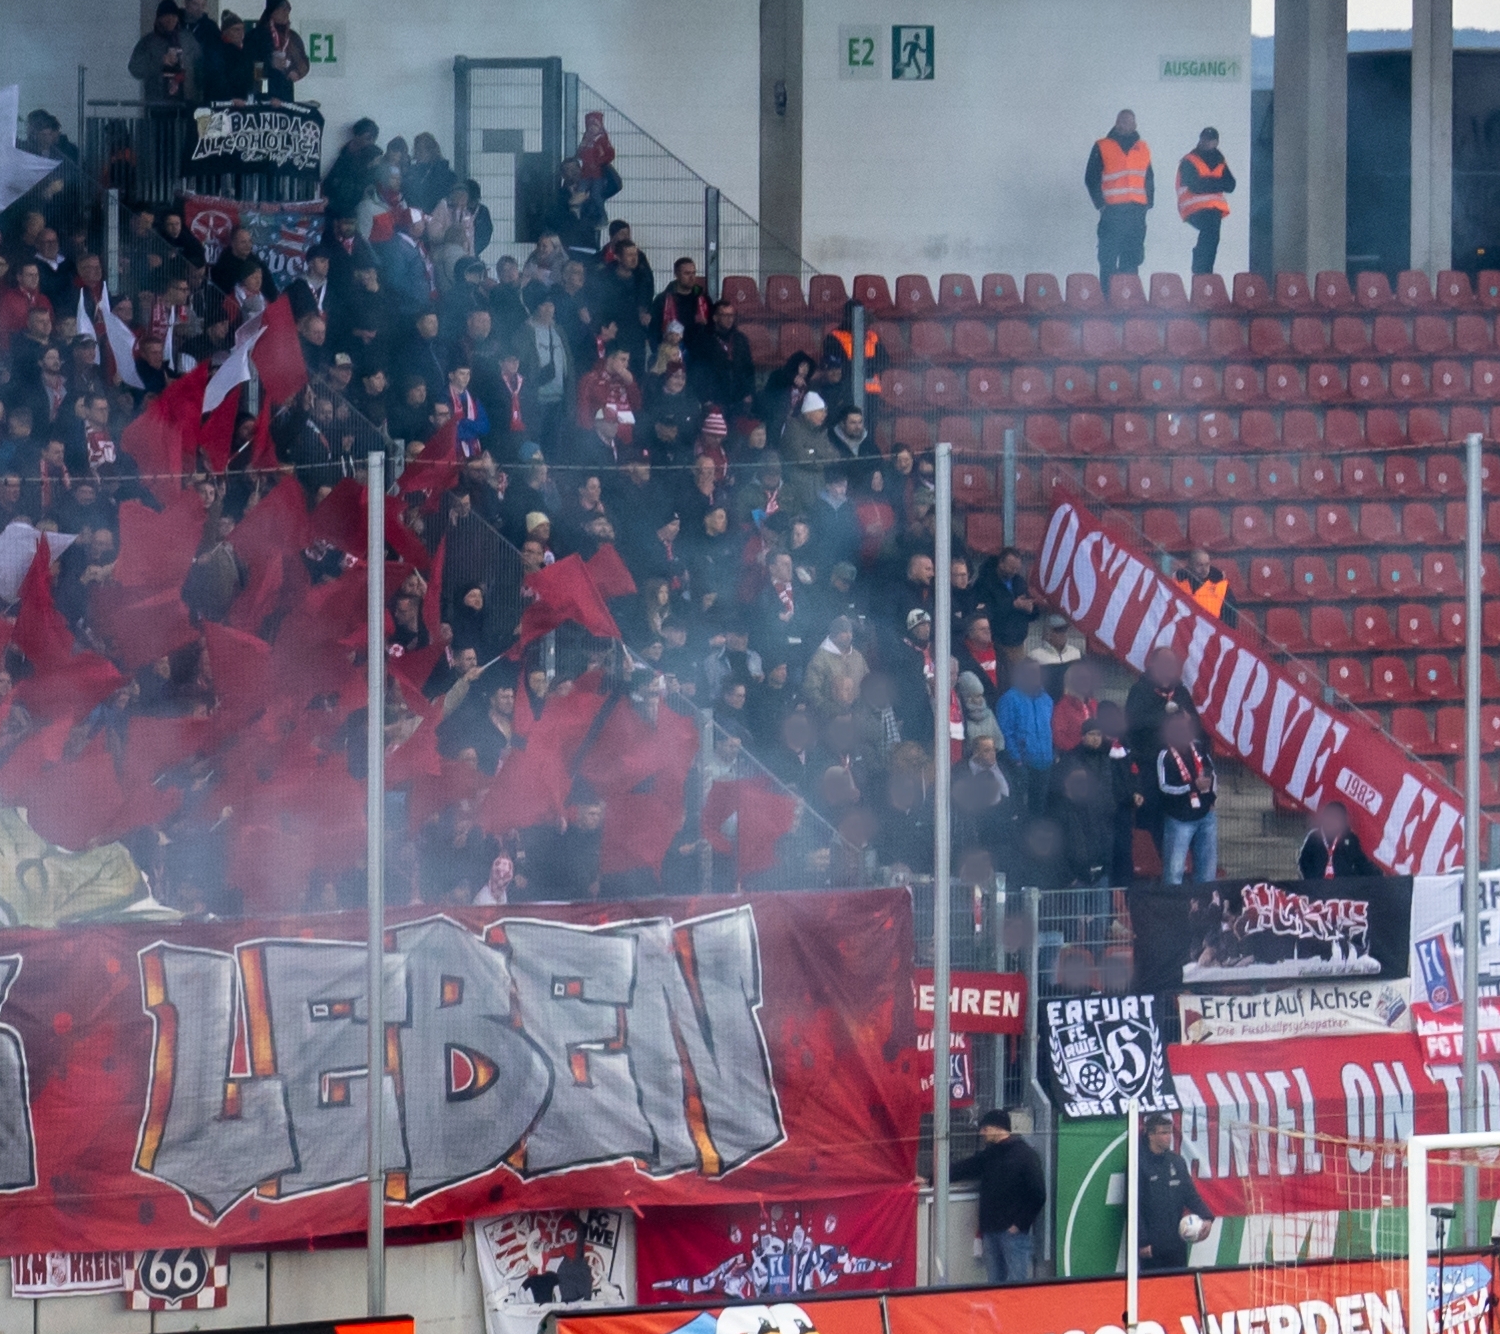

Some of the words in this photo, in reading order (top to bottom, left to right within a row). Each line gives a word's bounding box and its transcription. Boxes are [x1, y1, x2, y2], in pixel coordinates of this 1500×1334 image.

[309, 33, 338, 63] E1
[848, 37, 875, 66] E2
[1163, 59, 1228, 77] AUSGANG
[230, 111, 302, 133] BANDA
[1039, 503, 1349, 811] OSTKURVE
[1342, 767, 1376, 807] 1982
[1451, 919, 1491, 947] AF
[911, 979, 1020, 1017] EHREN
[1046, 995, 1155, 1026] ERFURT
[1200, 994, 1272, 1023] Erfurt
[1274, 988, 1306, 1017] Auf
[1310, 985, 1374, 1012] Achse
[131, 906, 788, 1226] LEBEN
[1168, 1066, 1322, 1180] ANIEL
[1341, 1060, 1415, 1173] ON
[150, 1248, 199, 1290] 66
